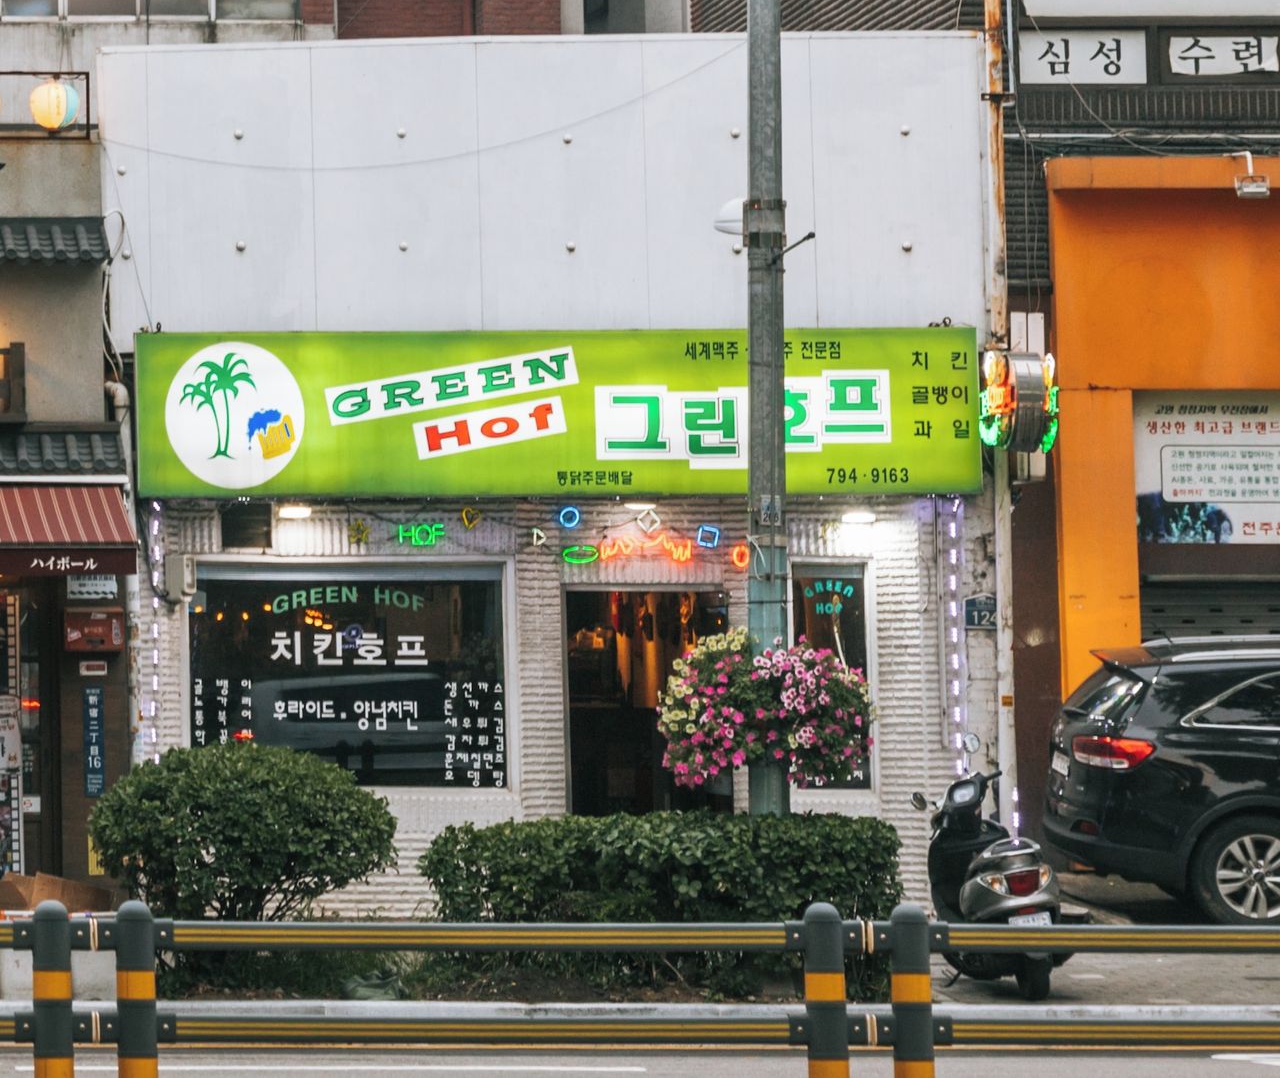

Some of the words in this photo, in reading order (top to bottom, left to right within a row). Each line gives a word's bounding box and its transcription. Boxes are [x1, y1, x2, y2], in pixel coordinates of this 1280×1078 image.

[1038, 38, 1122, 76] 심성
[1178, 36, 1264, 75] 수련
[684, 341, 739, 361] 세계맥주
[801, 340, 841, 360] 전문점
[911, 351, 969, 371] 치킨
[331, 352, 570, 419] GREEN
[911, 385, 970, 405] 골뱅이
[423, 402, 554, 453] Hof
[913, 419, 971, 439] 과일
[1145, 420, 1186, 434] 생산한
[1193, 420, 1234, 434] 최고급
[556, 470, 633, 486] 통닭주문배달
[399, 523, 446, 547] HOF
[30, 556, 99, 571] ハイボール
[804, 579, 855, 599] GREEN
[271, 585, 359, 615] GREEN
[374, 586, 425, 613] HOF
[270, 630, 429, 666] 치킨호프
[444, 682, 503, 698] 생선까스
[273, 700, 335, 720] 후라이드
[353, 700, 418, 731] 양념치킨
[444, 699, 503, 716] 돈까스
[444, 717, 503, 734] 새우튀김
[444, 734, 504, 751] 감자튀김
[444, 770, 504, 787] 오뎅탕
